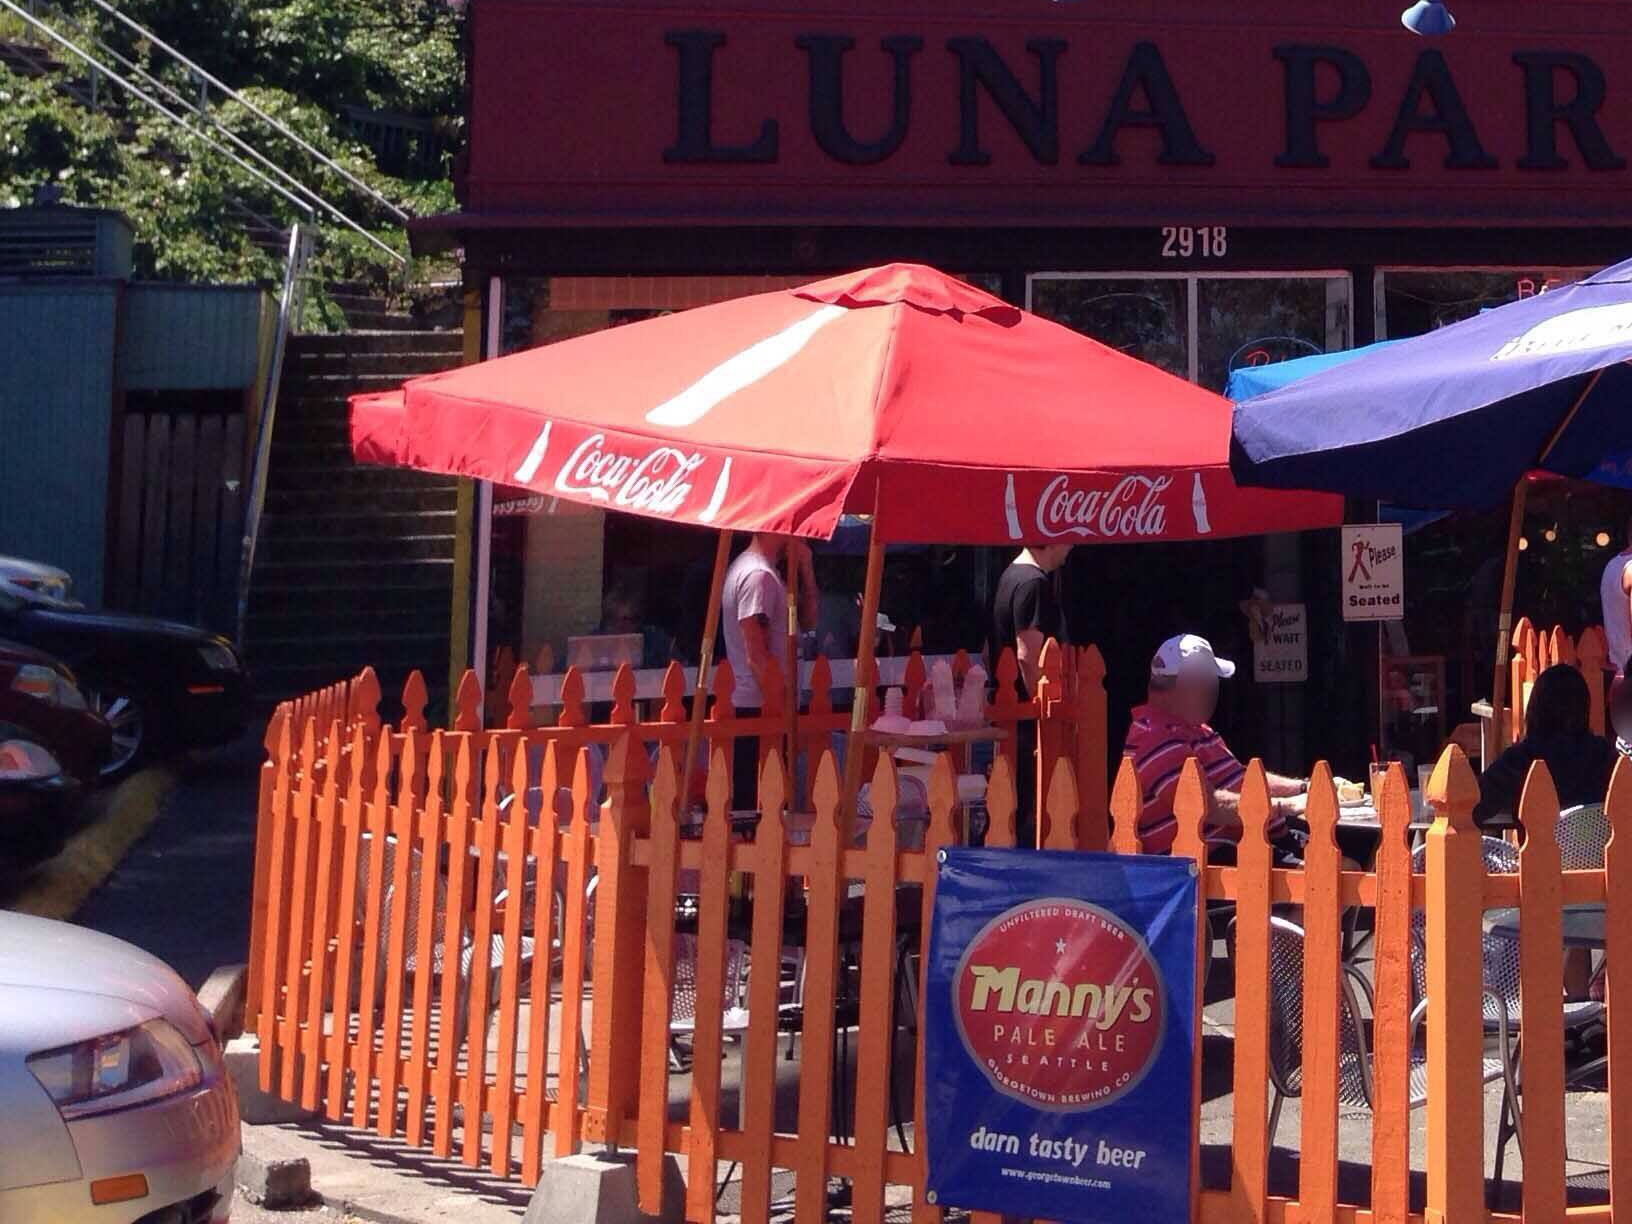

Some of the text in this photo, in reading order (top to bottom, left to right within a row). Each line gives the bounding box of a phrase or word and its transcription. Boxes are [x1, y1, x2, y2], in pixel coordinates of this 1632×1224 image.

[662, 30, 1216, 167] LUNA
[1161, 226, 1227, 258] 2918
[1348, 592, 1400, 608] Seated
[999, 907, 1125, 942] UNFILTERED DRAFT BEER
[970, 964, 1154, 1031] Manny's
[994, 1025, 1125, 1052] PALE ALE
[1006, 1053, 1109, 1072] SEATTLE
[987, 1058, 1056, 1103] GEORGETOWN
[1061, 1084, 1111, 1103] BREWING
[970, 1126, 1147, 1170] darn tasty beer
